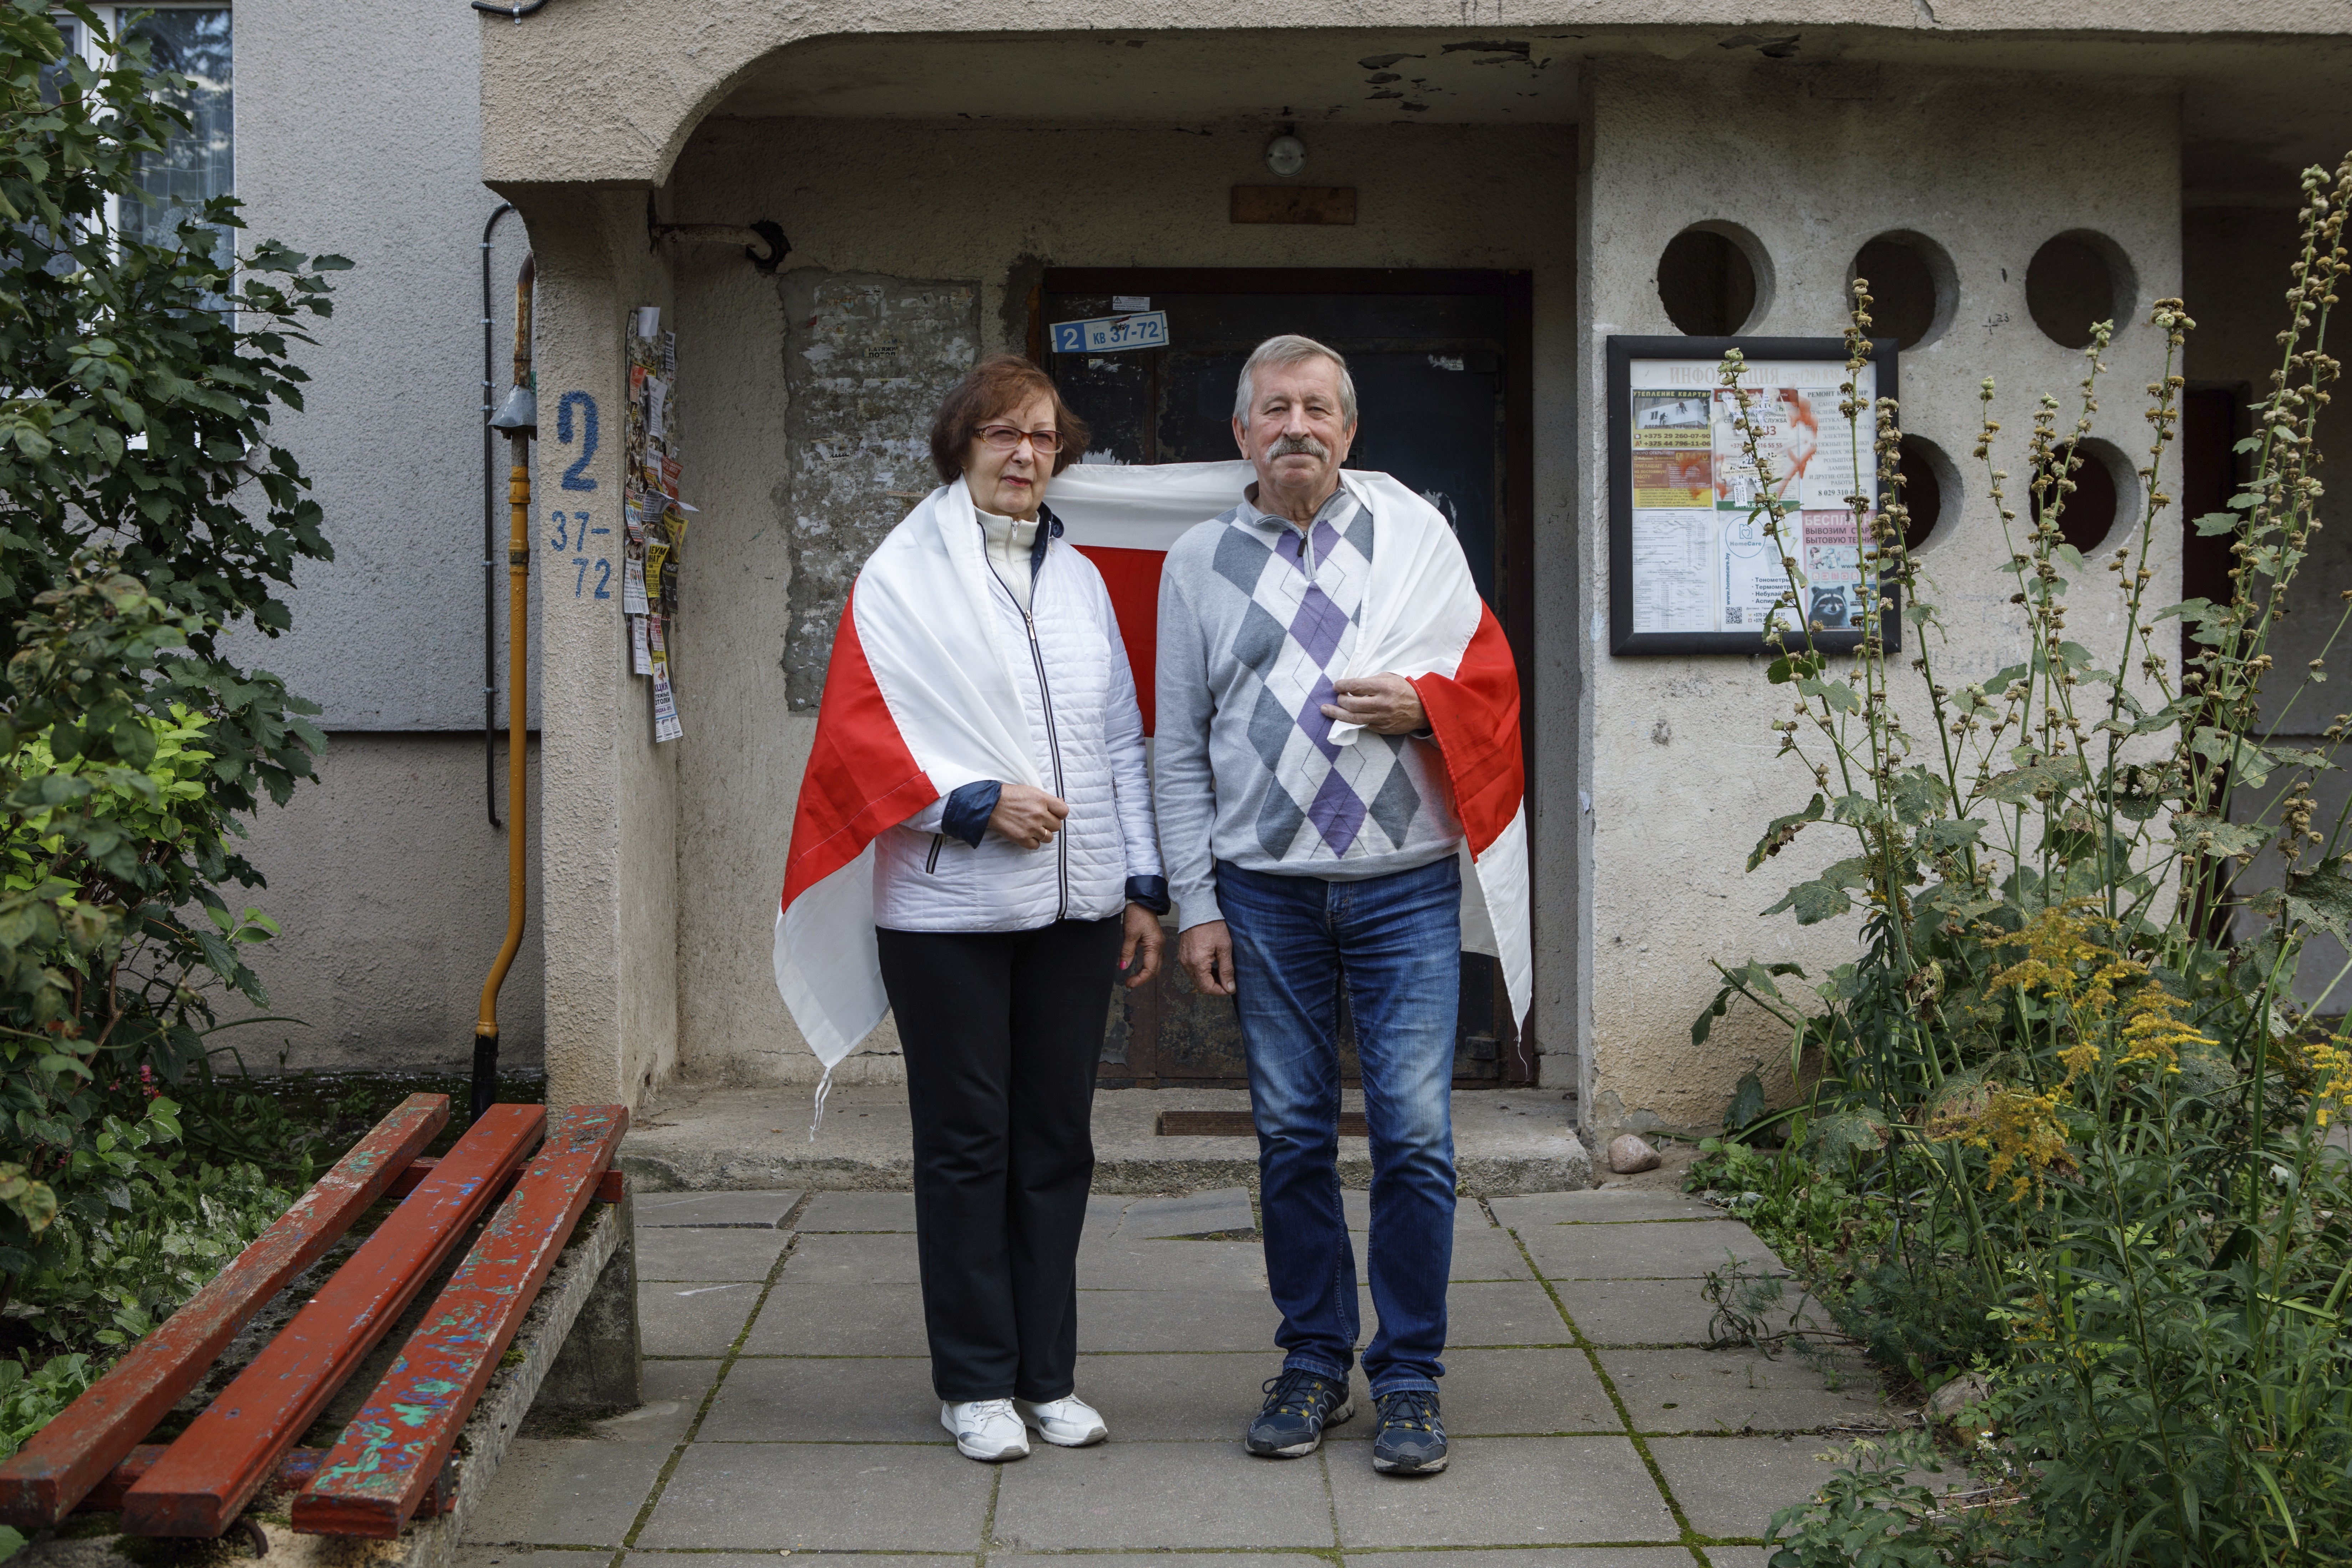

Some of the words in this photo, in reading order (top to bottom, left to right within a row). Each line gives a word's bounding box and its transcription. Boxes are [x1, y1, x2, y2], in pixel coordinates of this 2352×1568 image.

[1063, 328, 1079, 350] 2
[1093, 332, 1106, 345] КВ
[1110, 321, 1159, 342] 37-72
[1670, 367, 1779, 386] ИНФОАЦИЯ
[557, 390, 599, 492] 2
[551, 511, 610, 552] 37-
[572, 558, 611, 599] 72
